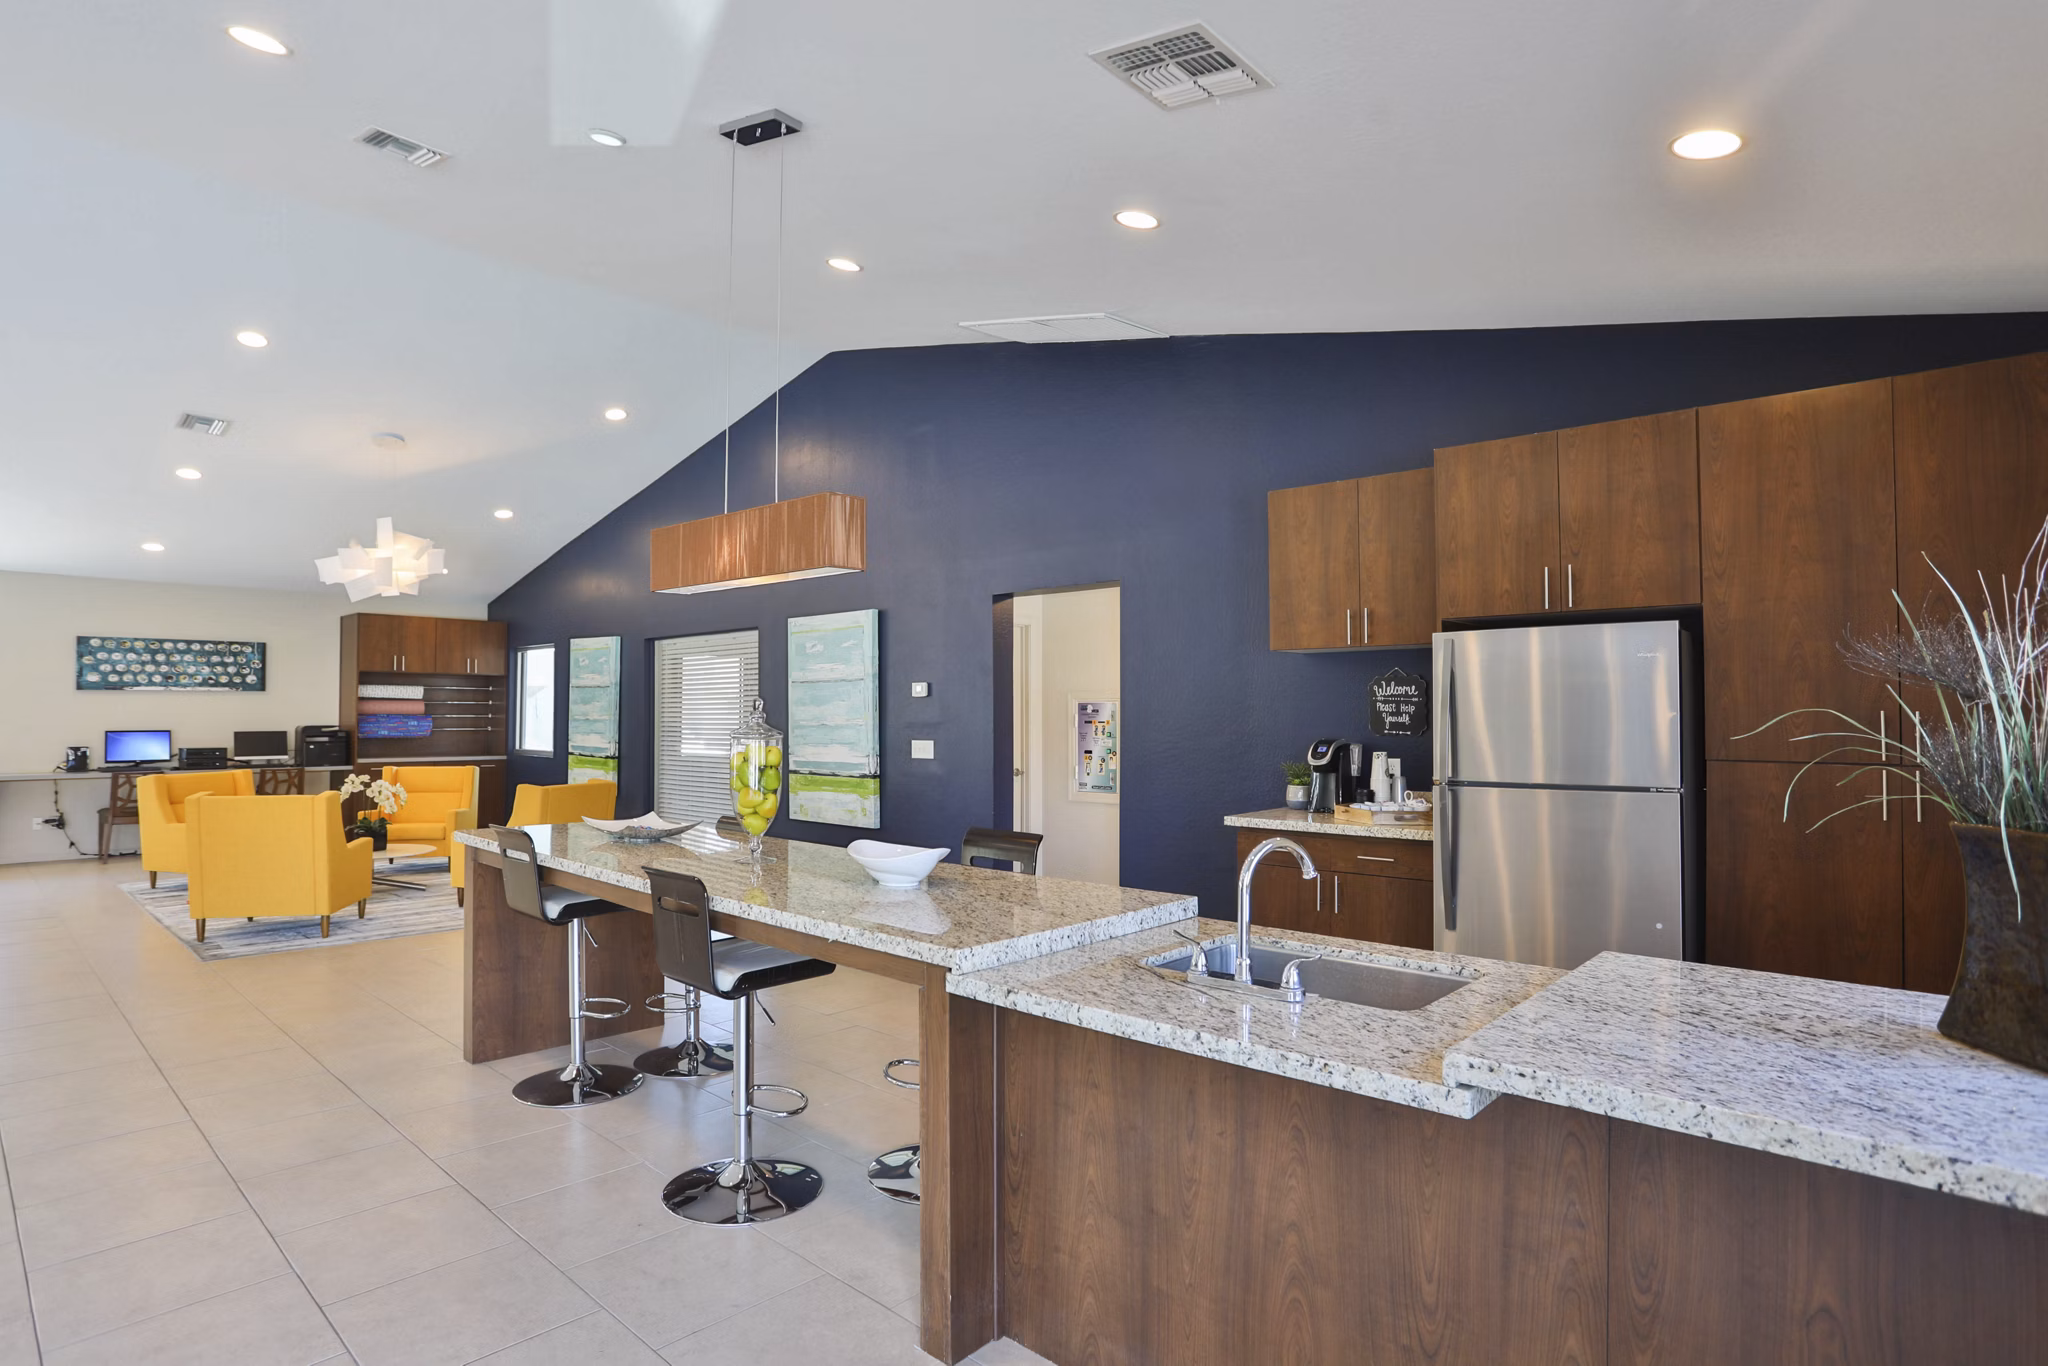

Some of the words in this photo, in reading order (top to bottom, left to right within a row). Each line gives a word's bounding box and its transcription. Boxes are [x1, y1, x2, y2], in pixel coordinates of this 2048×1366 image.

[1373, 681, 1418, 696] Welcome
[1376, 702, 1397, 712] Please
[1400, 703, 1416, 714] Help
